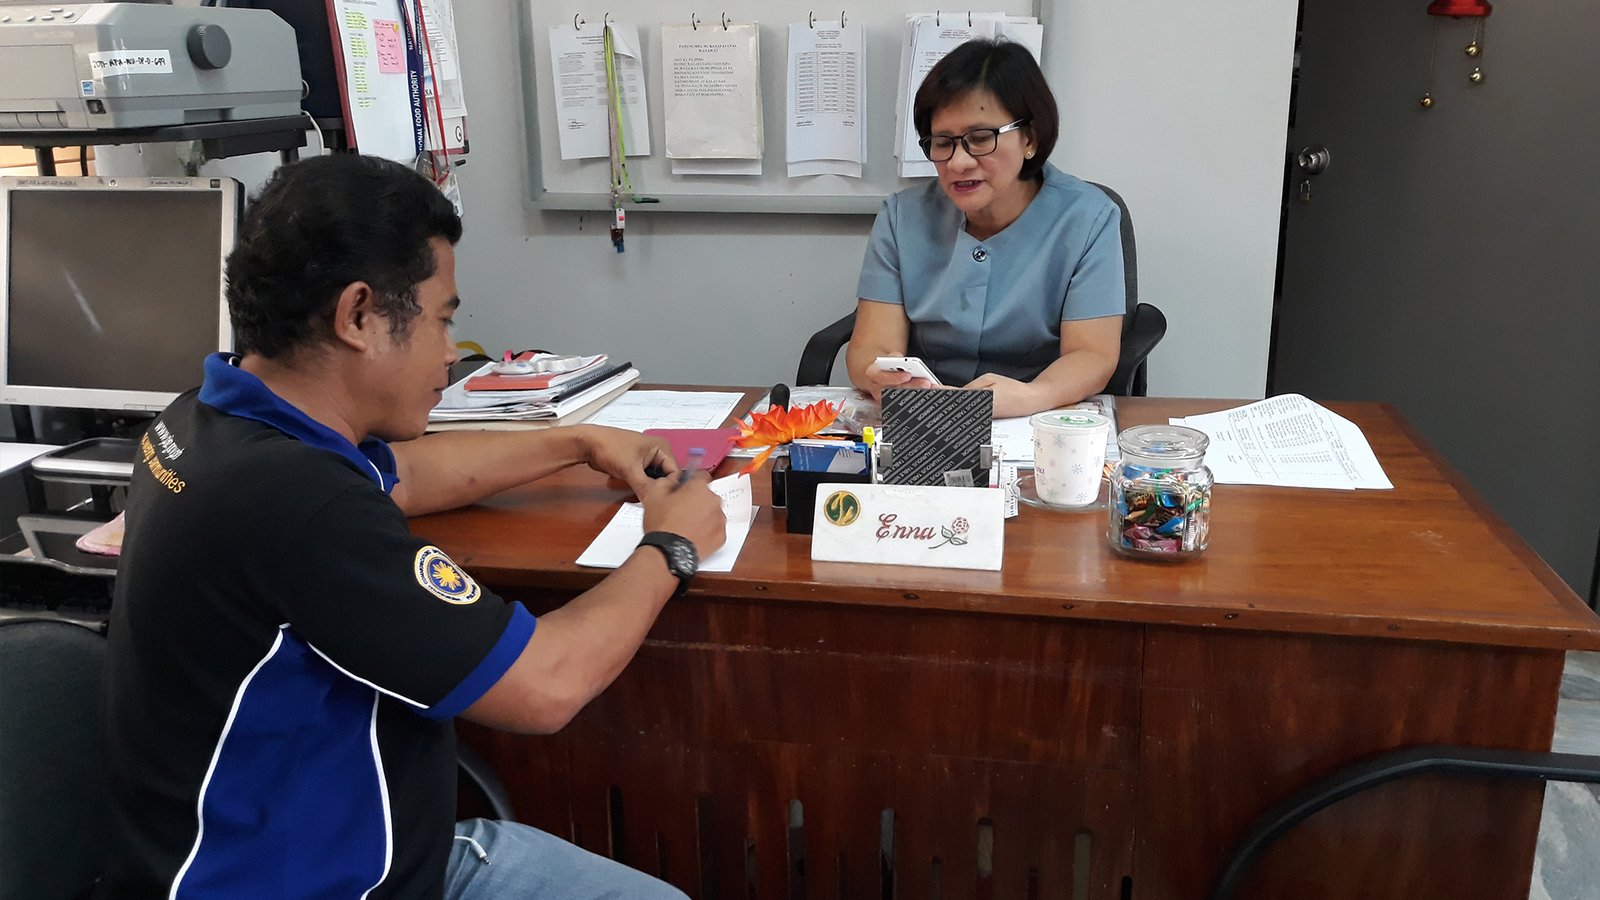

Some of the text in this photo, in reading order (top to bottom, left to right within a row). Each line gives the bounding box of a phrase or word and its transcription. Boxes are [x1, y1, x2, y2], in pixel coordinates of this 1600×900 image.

[410, 70, 421, 108] AUTHORITY
[414, 107, 422, 127] FOOD
[950, 408, 966, 422] TABLE
[960, 416, 975, 429] TABLE
[934, 419, 953, 435] MIRROR
[943, 426, 962, 442] MIRROR
[969, 423, 984, 436] TABLE
[902, 439, 927, 460] LUXURIOUS
[952, 433, 971, 449] MIRROR
[911, 446, 936, 467] LUXURIOUS
[920, 453, 945, 474] LUXURIOUS
[875, 513, 937, 544] Enna
